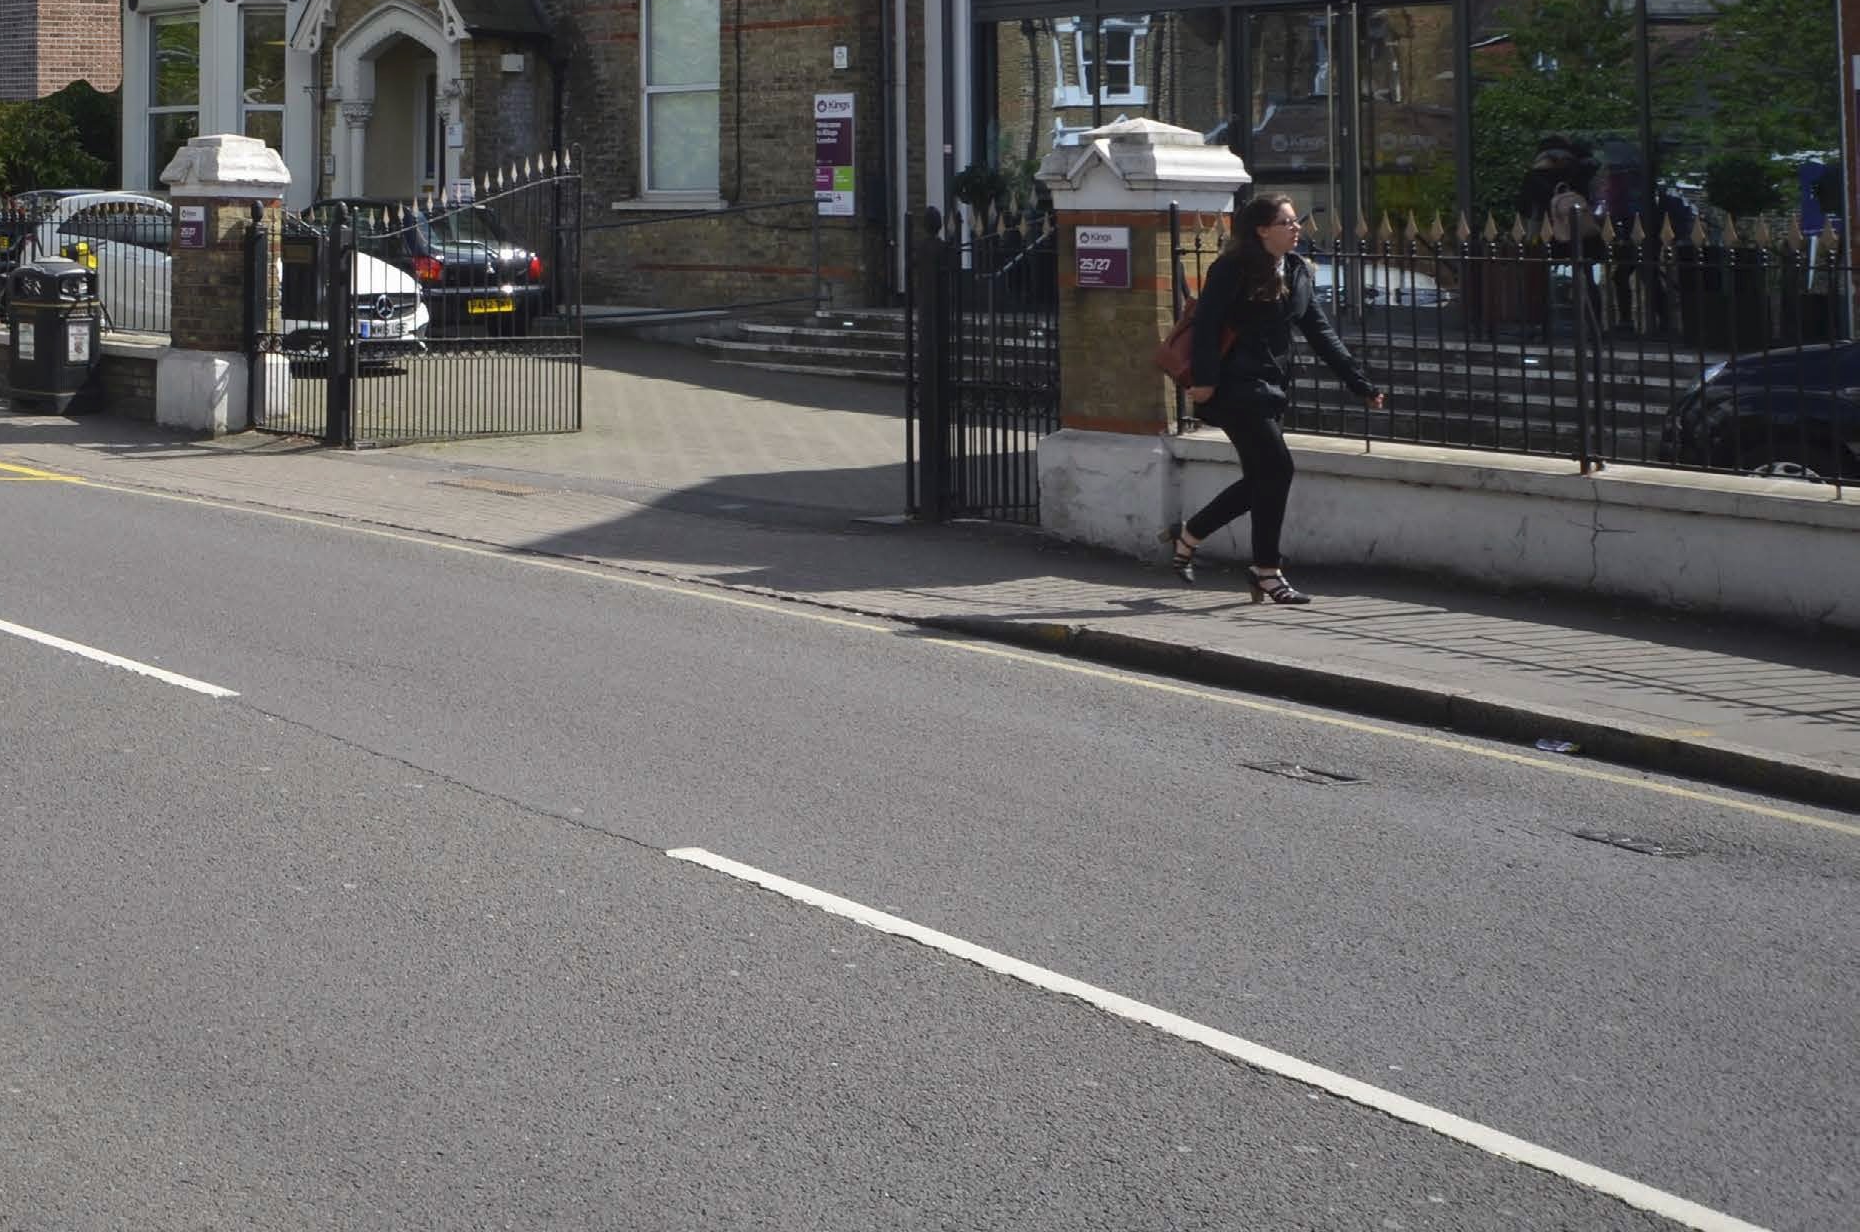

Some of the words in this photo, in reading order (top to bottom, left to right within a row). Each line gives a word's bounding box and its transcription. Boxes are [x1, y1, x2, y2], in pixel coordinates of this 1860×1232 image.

[828, 100, 850, 111] Kings
[1090, 231, 1112, 243] Kings
[1079, 258, 1111, 271] 25/27
